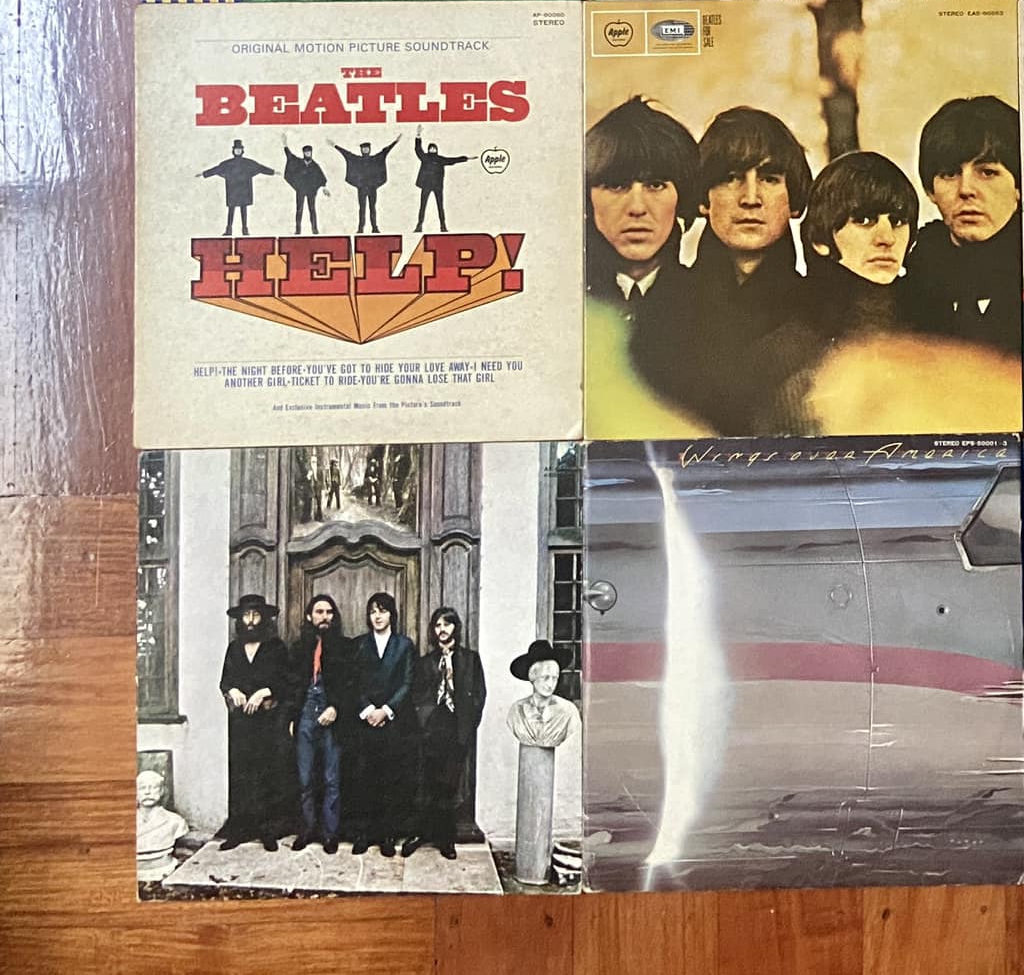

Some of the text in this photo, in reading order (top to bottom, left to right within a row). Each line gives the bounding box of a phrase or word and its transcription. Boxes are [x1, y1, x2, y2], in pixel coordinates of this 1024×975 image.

[608, 27, 629, 37] Apple
[231, 40, 490, 54] ORIGINAL MOTION PICTURE SOUNDTRACK
[341, 67, 382, 78] THE
[195, 80, 530, 126] BEATLES
[485, 155, 506, 165] Apple
[190, 232, 526, 300] HELP!
[241, 361, 523, 375] NIGHT GOT TO HIDE YOUR LOVE NEED YOU
[224, 373, 495, 387] ANOTHER TO GONNA LOSE THAT GIRL
[681, 444, 777, 468] Wings
